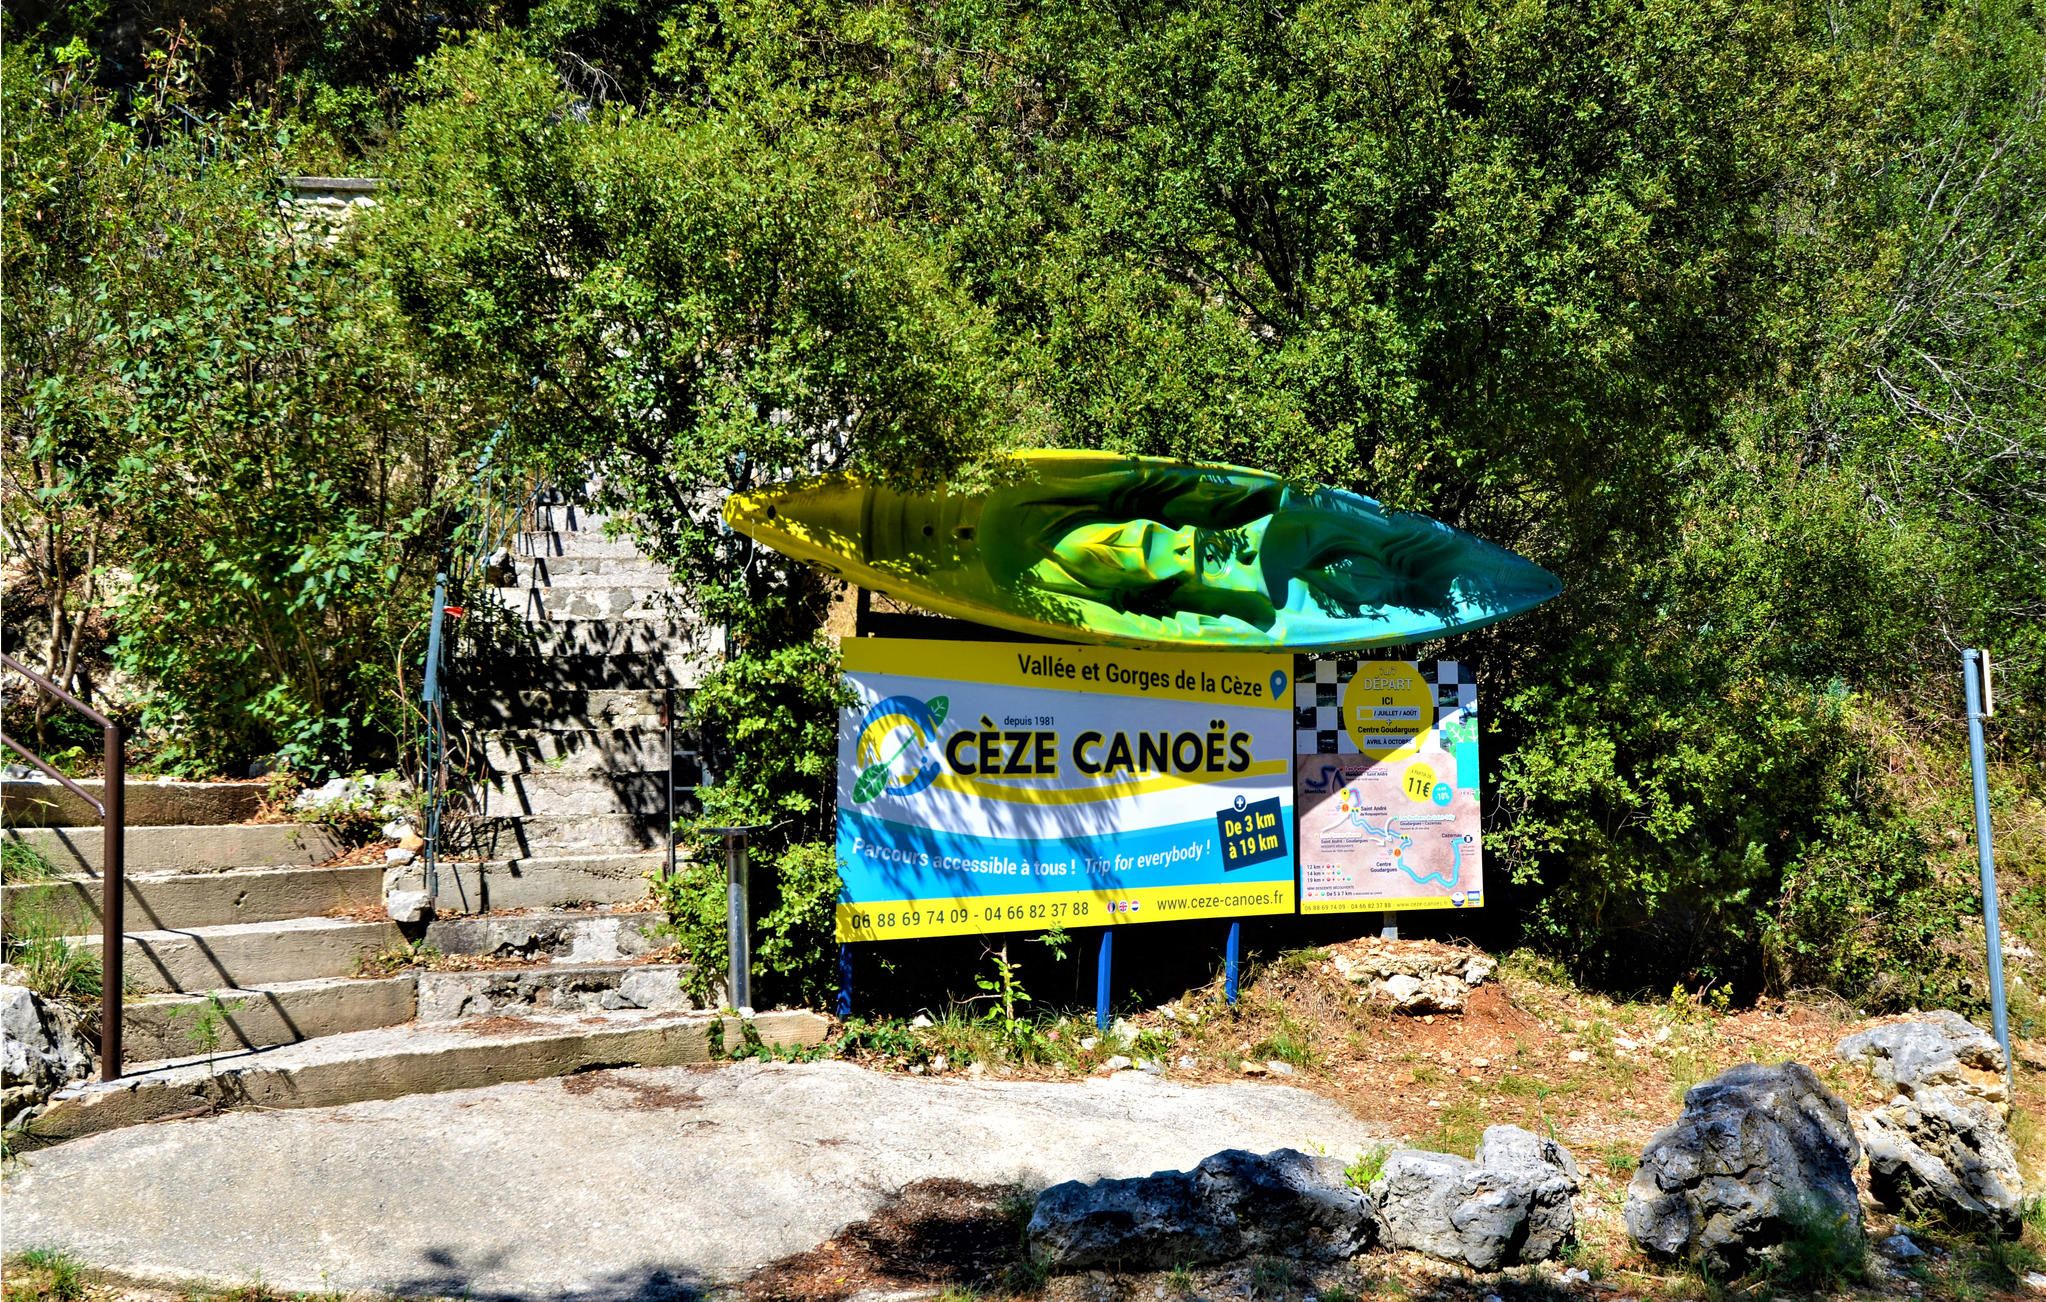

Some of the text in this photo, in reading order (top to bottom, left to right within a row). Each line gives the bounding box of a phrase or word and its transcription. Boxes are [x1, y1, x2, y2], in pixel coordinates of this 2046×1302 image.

[1017, 653, 1262, 697] Vallée et Gorges de la Cèze
[1363, 675, 1413, 690] DÉPART
[1381, 697, 1393, 705] ICI
[1003, 716, 1055, 727] depuis 1981
[1380, 726, 1419, 734] Goudargues
[946, 715, 1250, 775] CÈZE CANOËS
[1409, 777, 1431, 798] 11€
[1225, 811, 1276, 838] De 3 km
[851, 837, 1076, 876] Parcours accessible à tous !
[1085, 839, 1211, 877] Trip for everybody !
[1229, 834, 1278, 860] à 19 km
[1157, 890, 1284, 910] www.ceze-canoes.fr
[851, 914, 871, 929] 06
[877, 912, 896, 927] 88
[902, 911, 921, 926] 69
[926, 910, 945, 925] 74
[950, 908, 968, 923] 09
[984, 907, 1002, 921] 04
[1007, 905, 1024, 920] 66
[1029, 904, 1046, 918] 82
[1051, 903, 1068, 917] 37
[1072, 902, 1089, 916] 88
